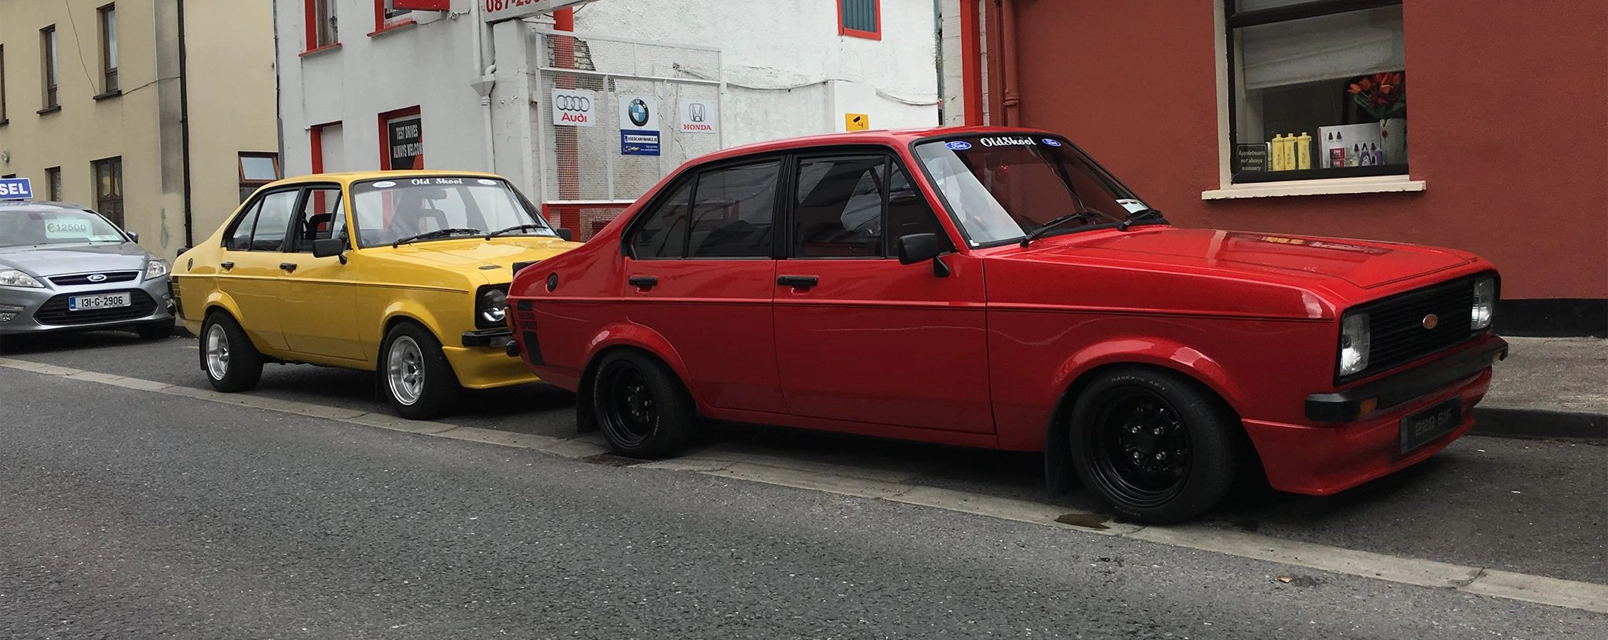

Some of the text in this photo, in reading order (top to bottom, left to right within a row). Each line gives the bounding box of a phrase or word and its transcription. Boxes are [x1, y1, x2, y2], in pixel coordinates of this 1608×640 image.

[561, 112, 588, 123] Audi
[395, 124, 419, 140] TEST DRIVES
[683, 123, 712, 131] HONDA
[393, 144, 408, 159] ALWAYS
[411, 178, 431, 186] Old
[0, 183, 28, 195] SEL
[47, 223, 87, 233] €12500
[81, 296, 124, 308] 131-G-2906
